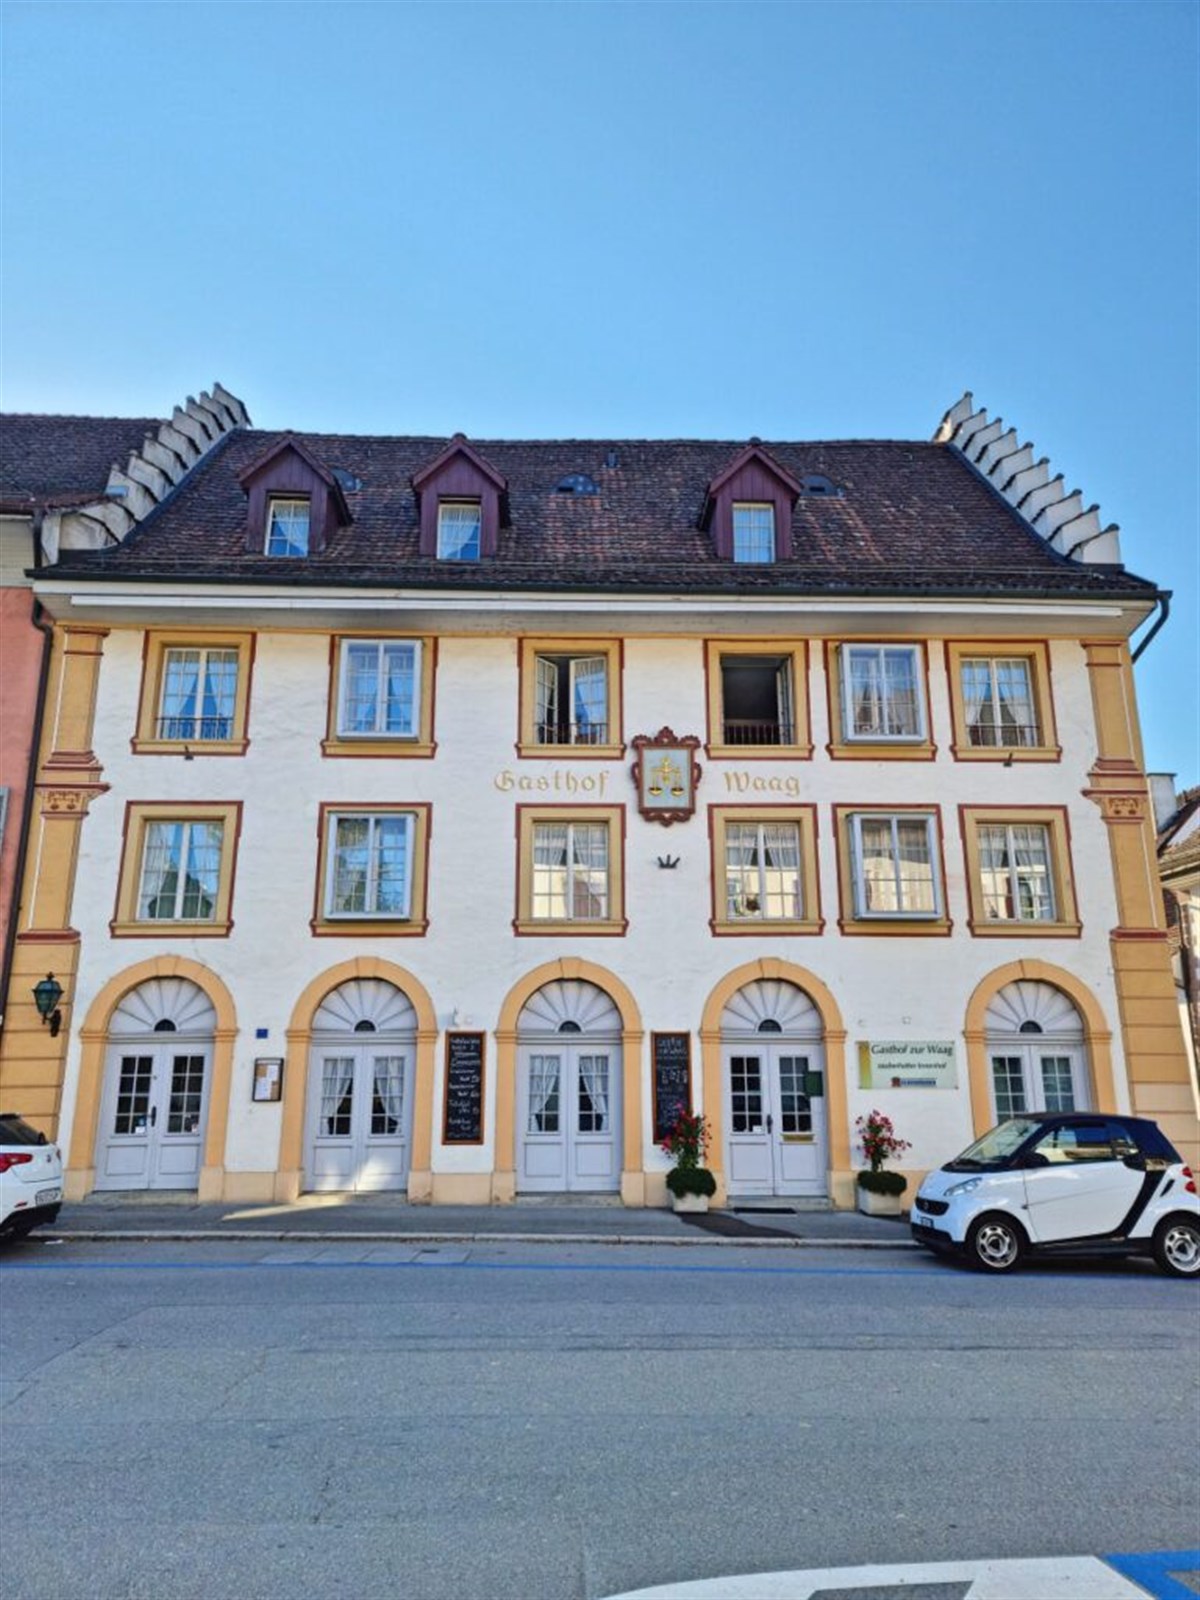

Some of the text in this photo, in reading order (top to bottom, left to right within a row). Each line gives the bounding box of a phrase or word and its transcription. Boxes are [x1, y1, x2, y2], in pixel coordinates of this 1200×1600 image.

[494, 770, 801, 797] Gasthof Waag
[871, 1044, 953, 1056] Gasthof zur Waag
